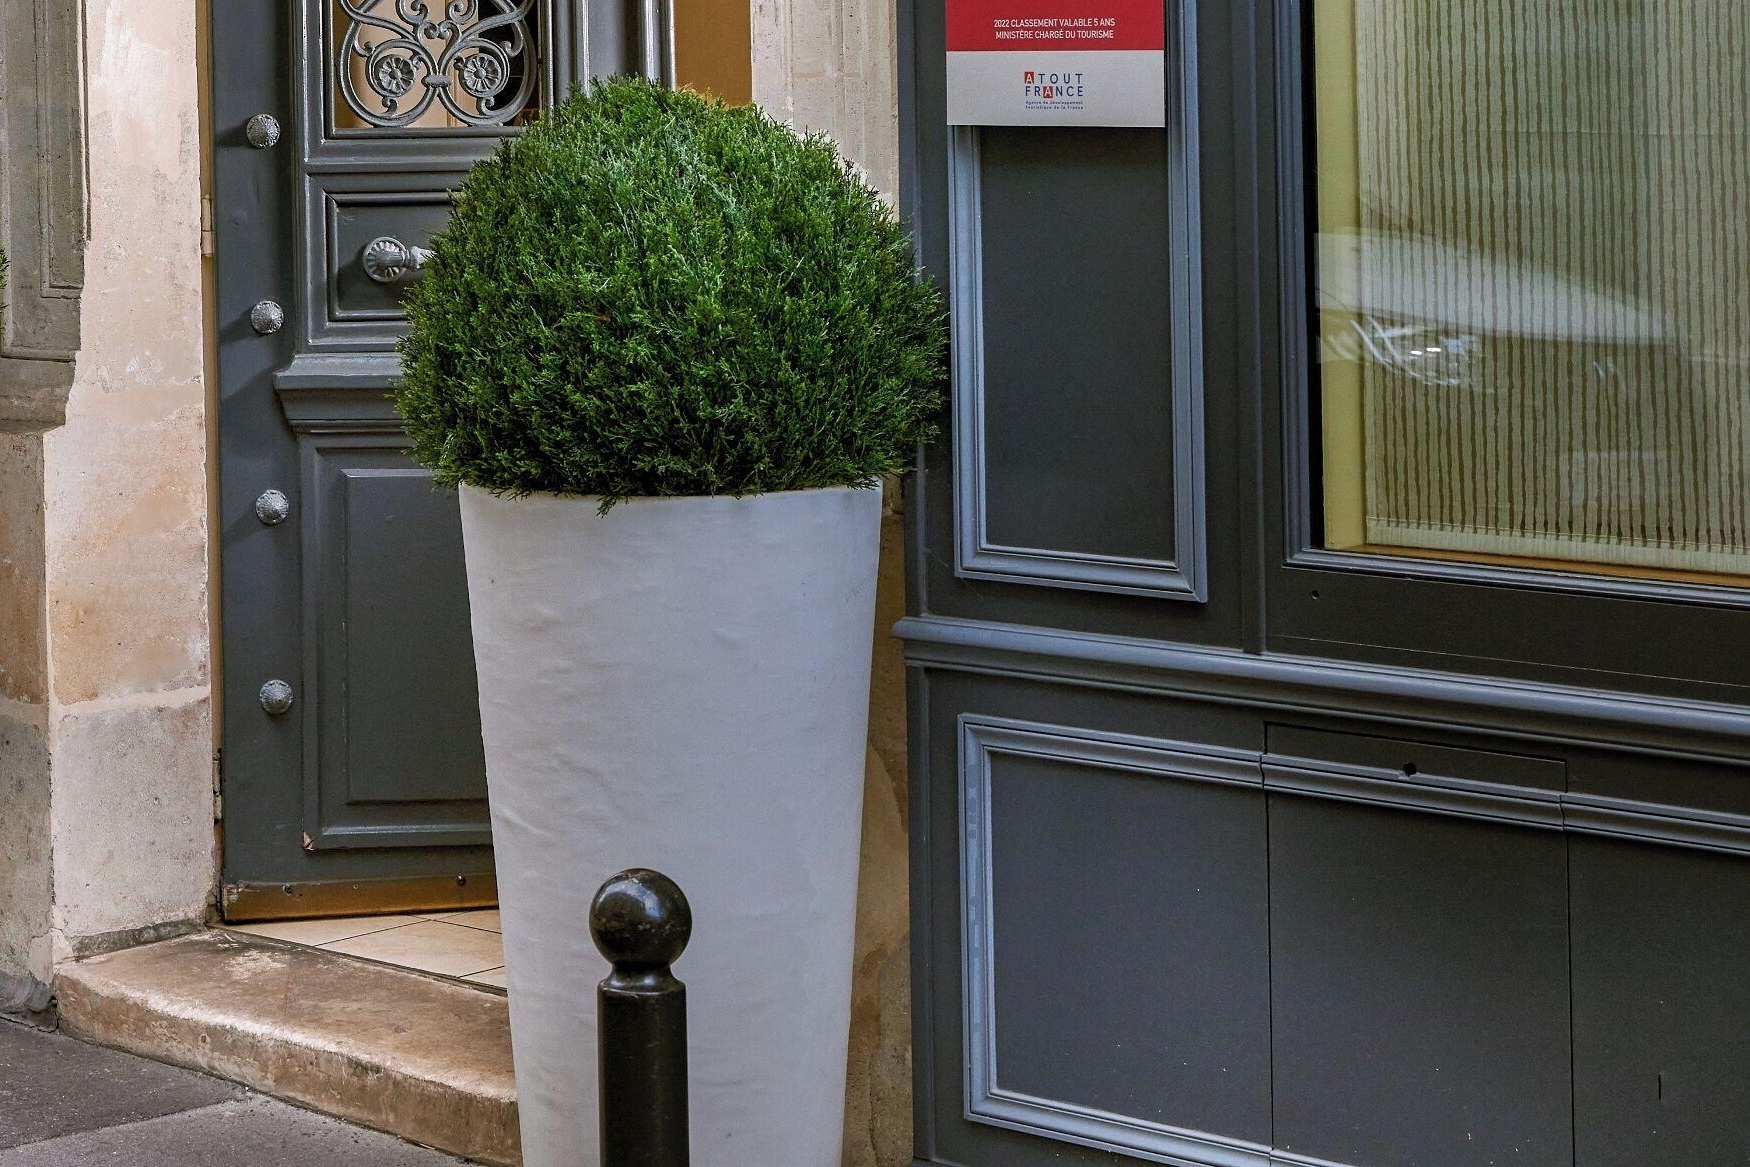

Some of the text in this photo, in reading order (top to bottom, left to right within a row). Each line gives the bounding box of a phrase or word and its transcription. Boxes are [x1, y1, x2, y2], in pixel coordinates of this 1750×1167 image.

[994, 18, 1116, 28] 2022 CLASSEMENT VALABLE 5 ANS
[995, 29, 1114, 39] MINISTÈRE CHARGÉ DU TOURISME
[1024, 72, 1083, 84] ATOUT
[1025, 85, 1084, 99] FRANCE
